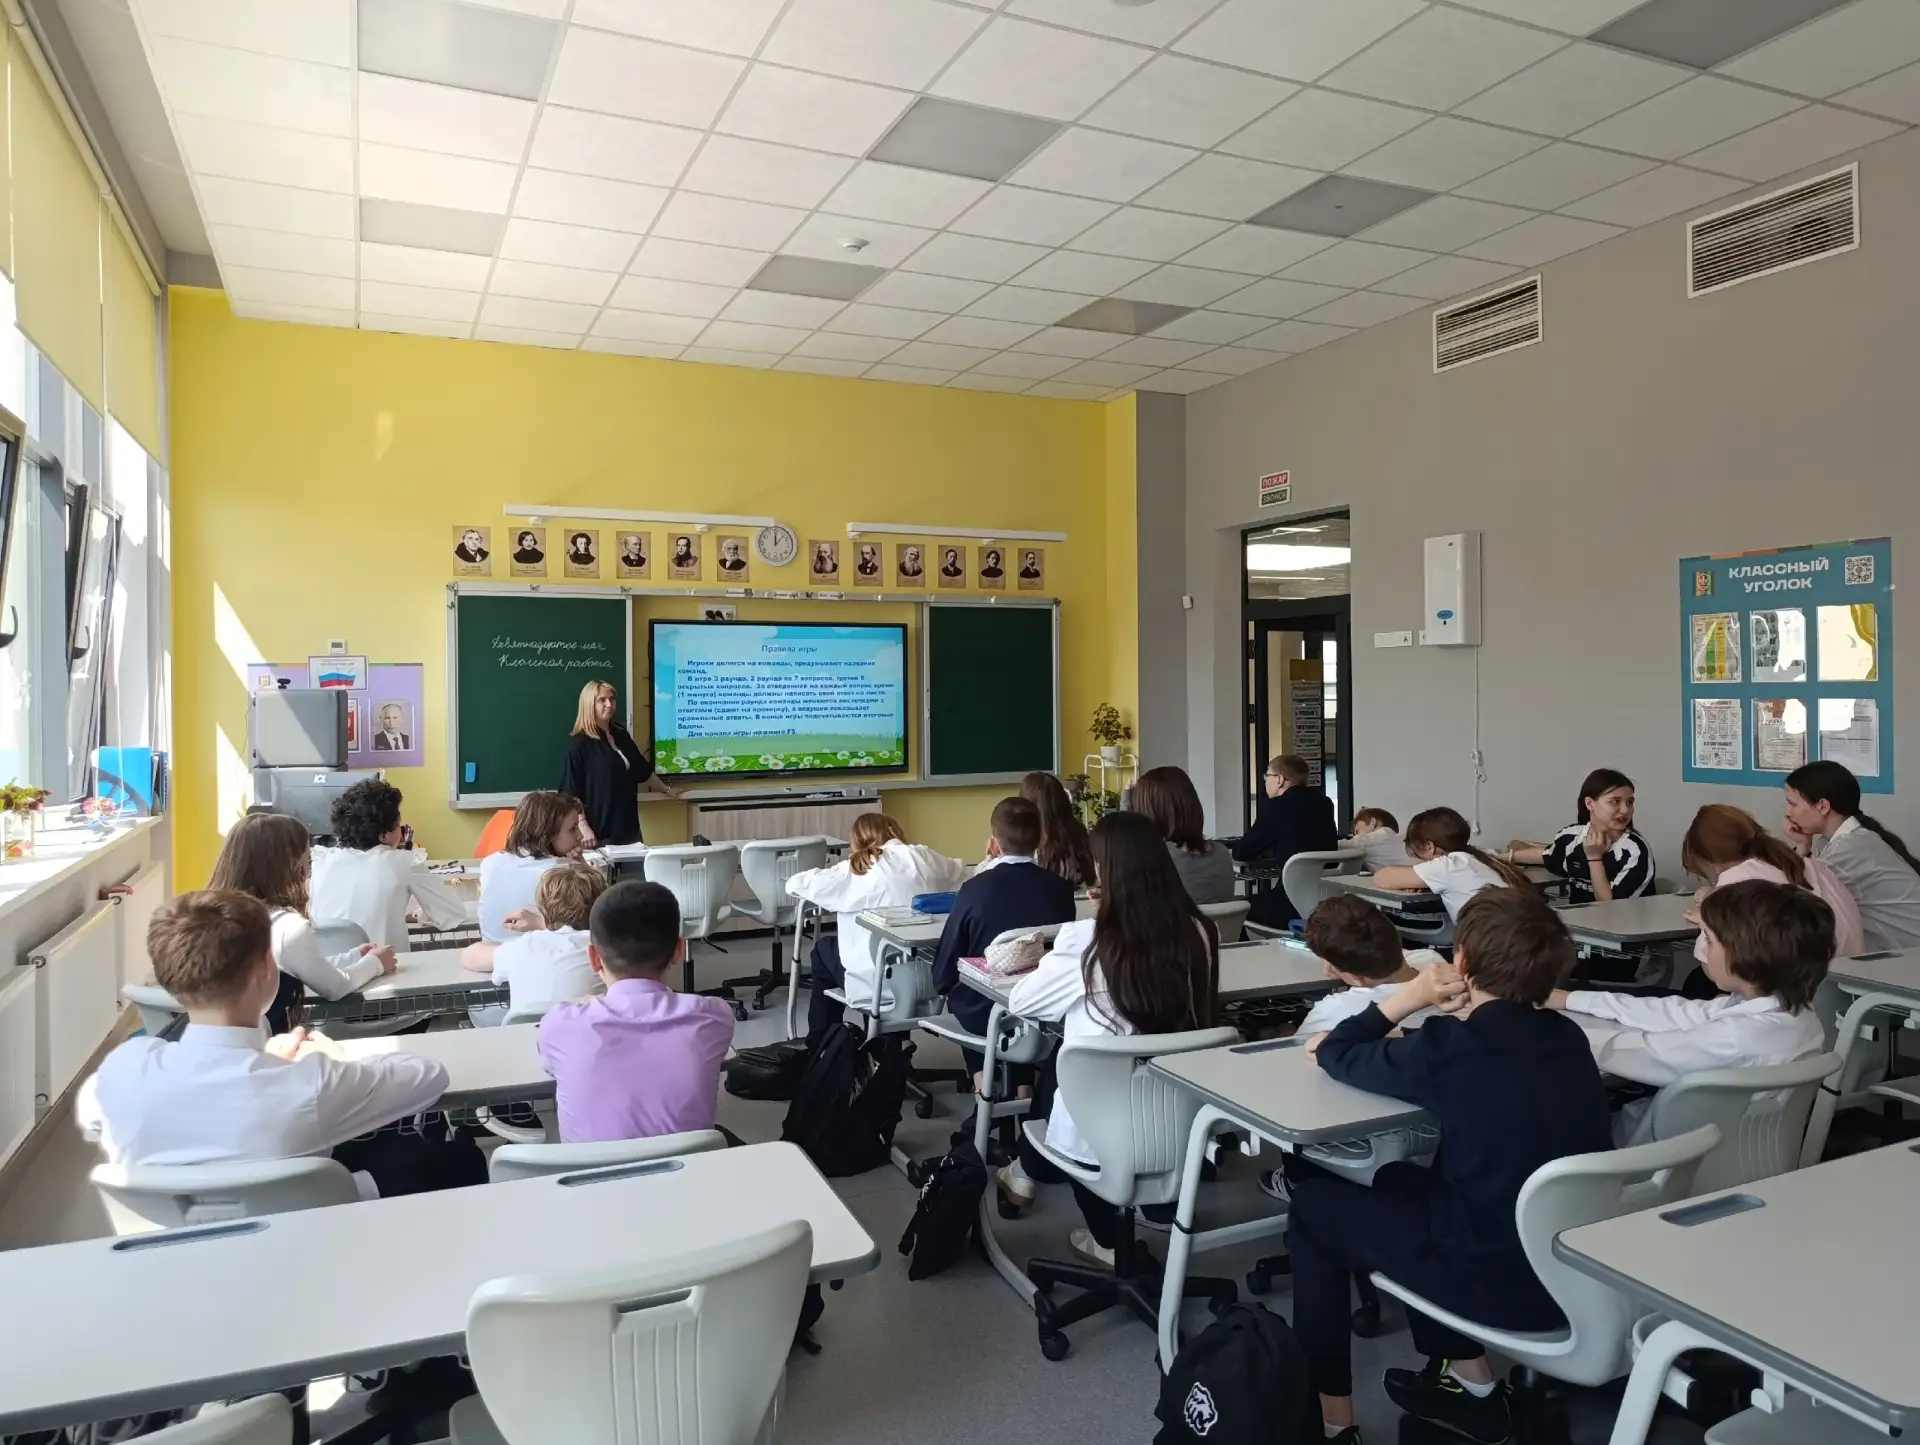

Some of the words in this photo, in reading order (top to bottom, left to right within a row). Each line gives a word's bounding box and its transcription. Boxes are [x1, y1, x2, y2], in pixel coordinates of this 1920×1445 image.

[1262, 474, 1287, 488] ПОЖАР
[1262, 490, 1287, 503] ЗВОНОК
[1728, 556, 1829, 579] КЛАССНЫЙ
[1743, 577, 1813, 593] УГОЛОК
[491, 634, 578, 655] Девятнадцатое
[762, 645, 795, 653] Правила
[564, 656, 615, 673] работа
